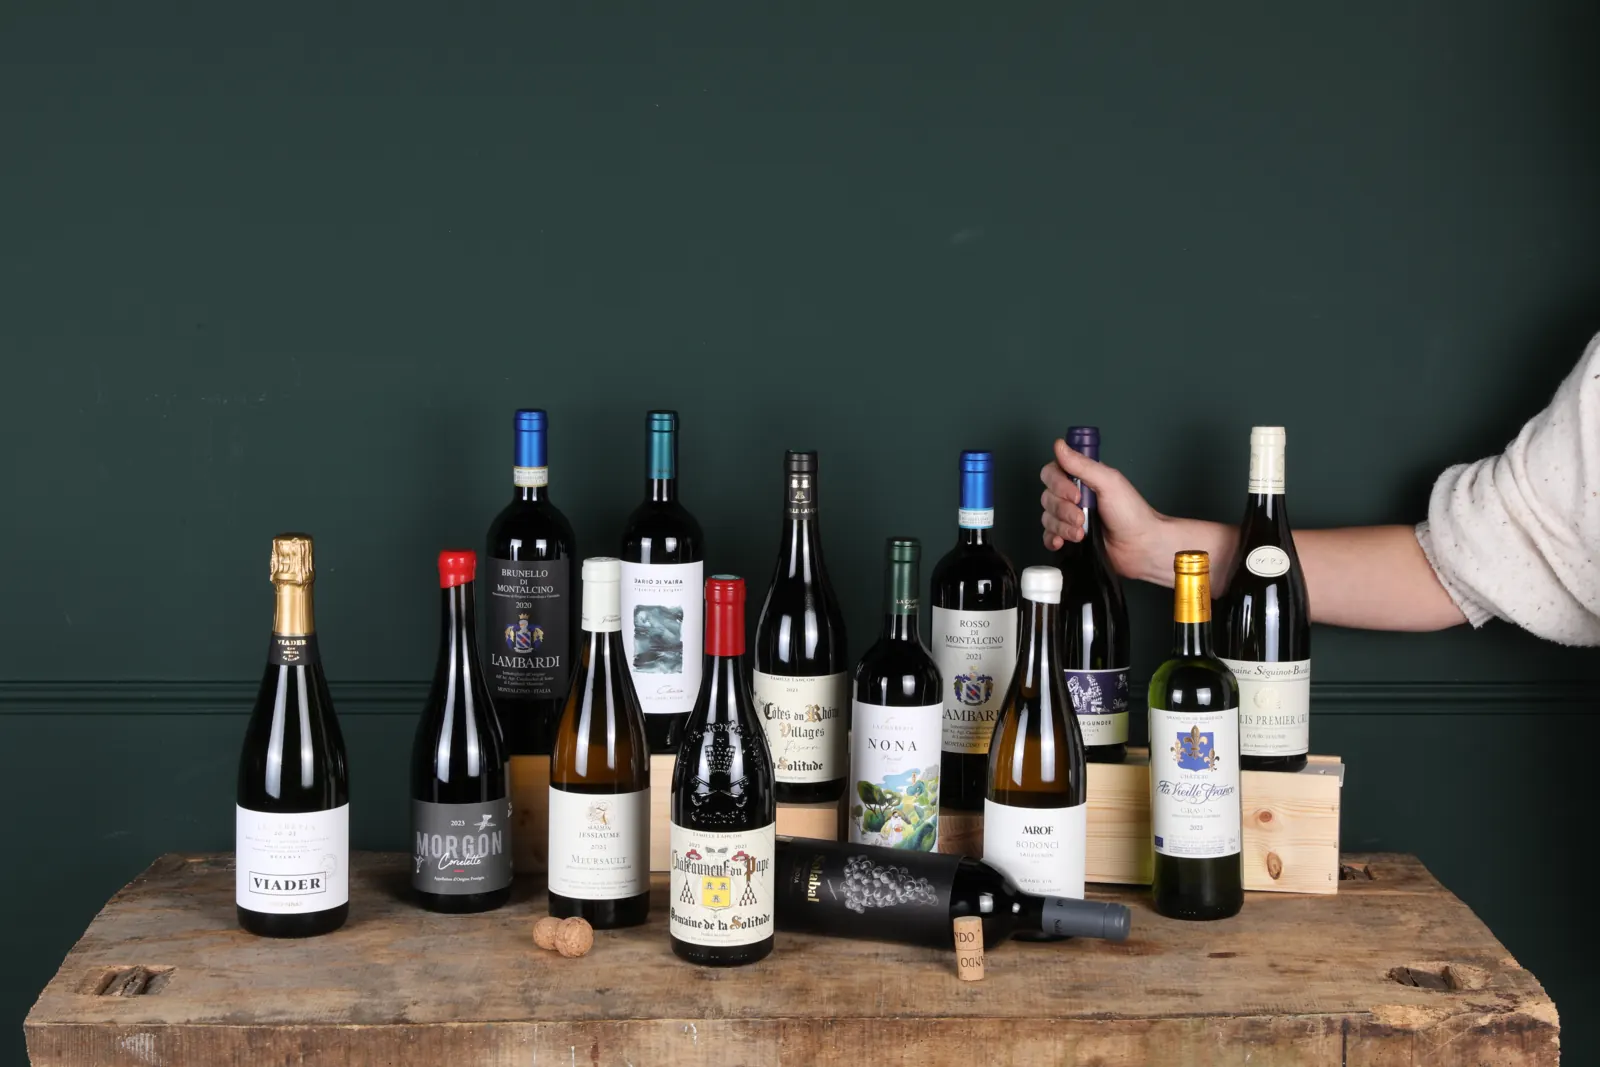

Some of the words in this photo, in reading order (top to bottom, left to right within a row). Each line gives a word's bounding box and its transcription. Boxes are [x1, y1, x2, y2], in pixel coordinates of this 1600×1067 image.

[501, 568, 549, 578] BRUNELLO
[497, 584, 554, 594] MONTALCINO
[515, 601, 532, 609] 2020
[959, 620, 990, 628] ROSSO
[945, 635, 1004, 645] MONTALCINO
[492, 653, 560, 669] LAMBARDI
[763, 702, 791, 720] Côtes
[793, 712, 804, 721] du
[1256, 715, 1296, 725] PREMIER
[779, 722, 825, 739] Villages
[868, 737, 917, 752] NONA
[777, 756, 824, 771] Solitude
[1170, 781, 1200, 801] Vieille
[416, 830, 502, 859] MORGON
[730, 868, 742, 876] du
[743, 855, 770, 882] Pape
[253, 877, 321, 891] VIADER
[670, 907, 703, 929] Domaine
[703, 918, 715, 930] de
[717, 919, 728, 930] la
[729, 913, 770, 930] Solitude
